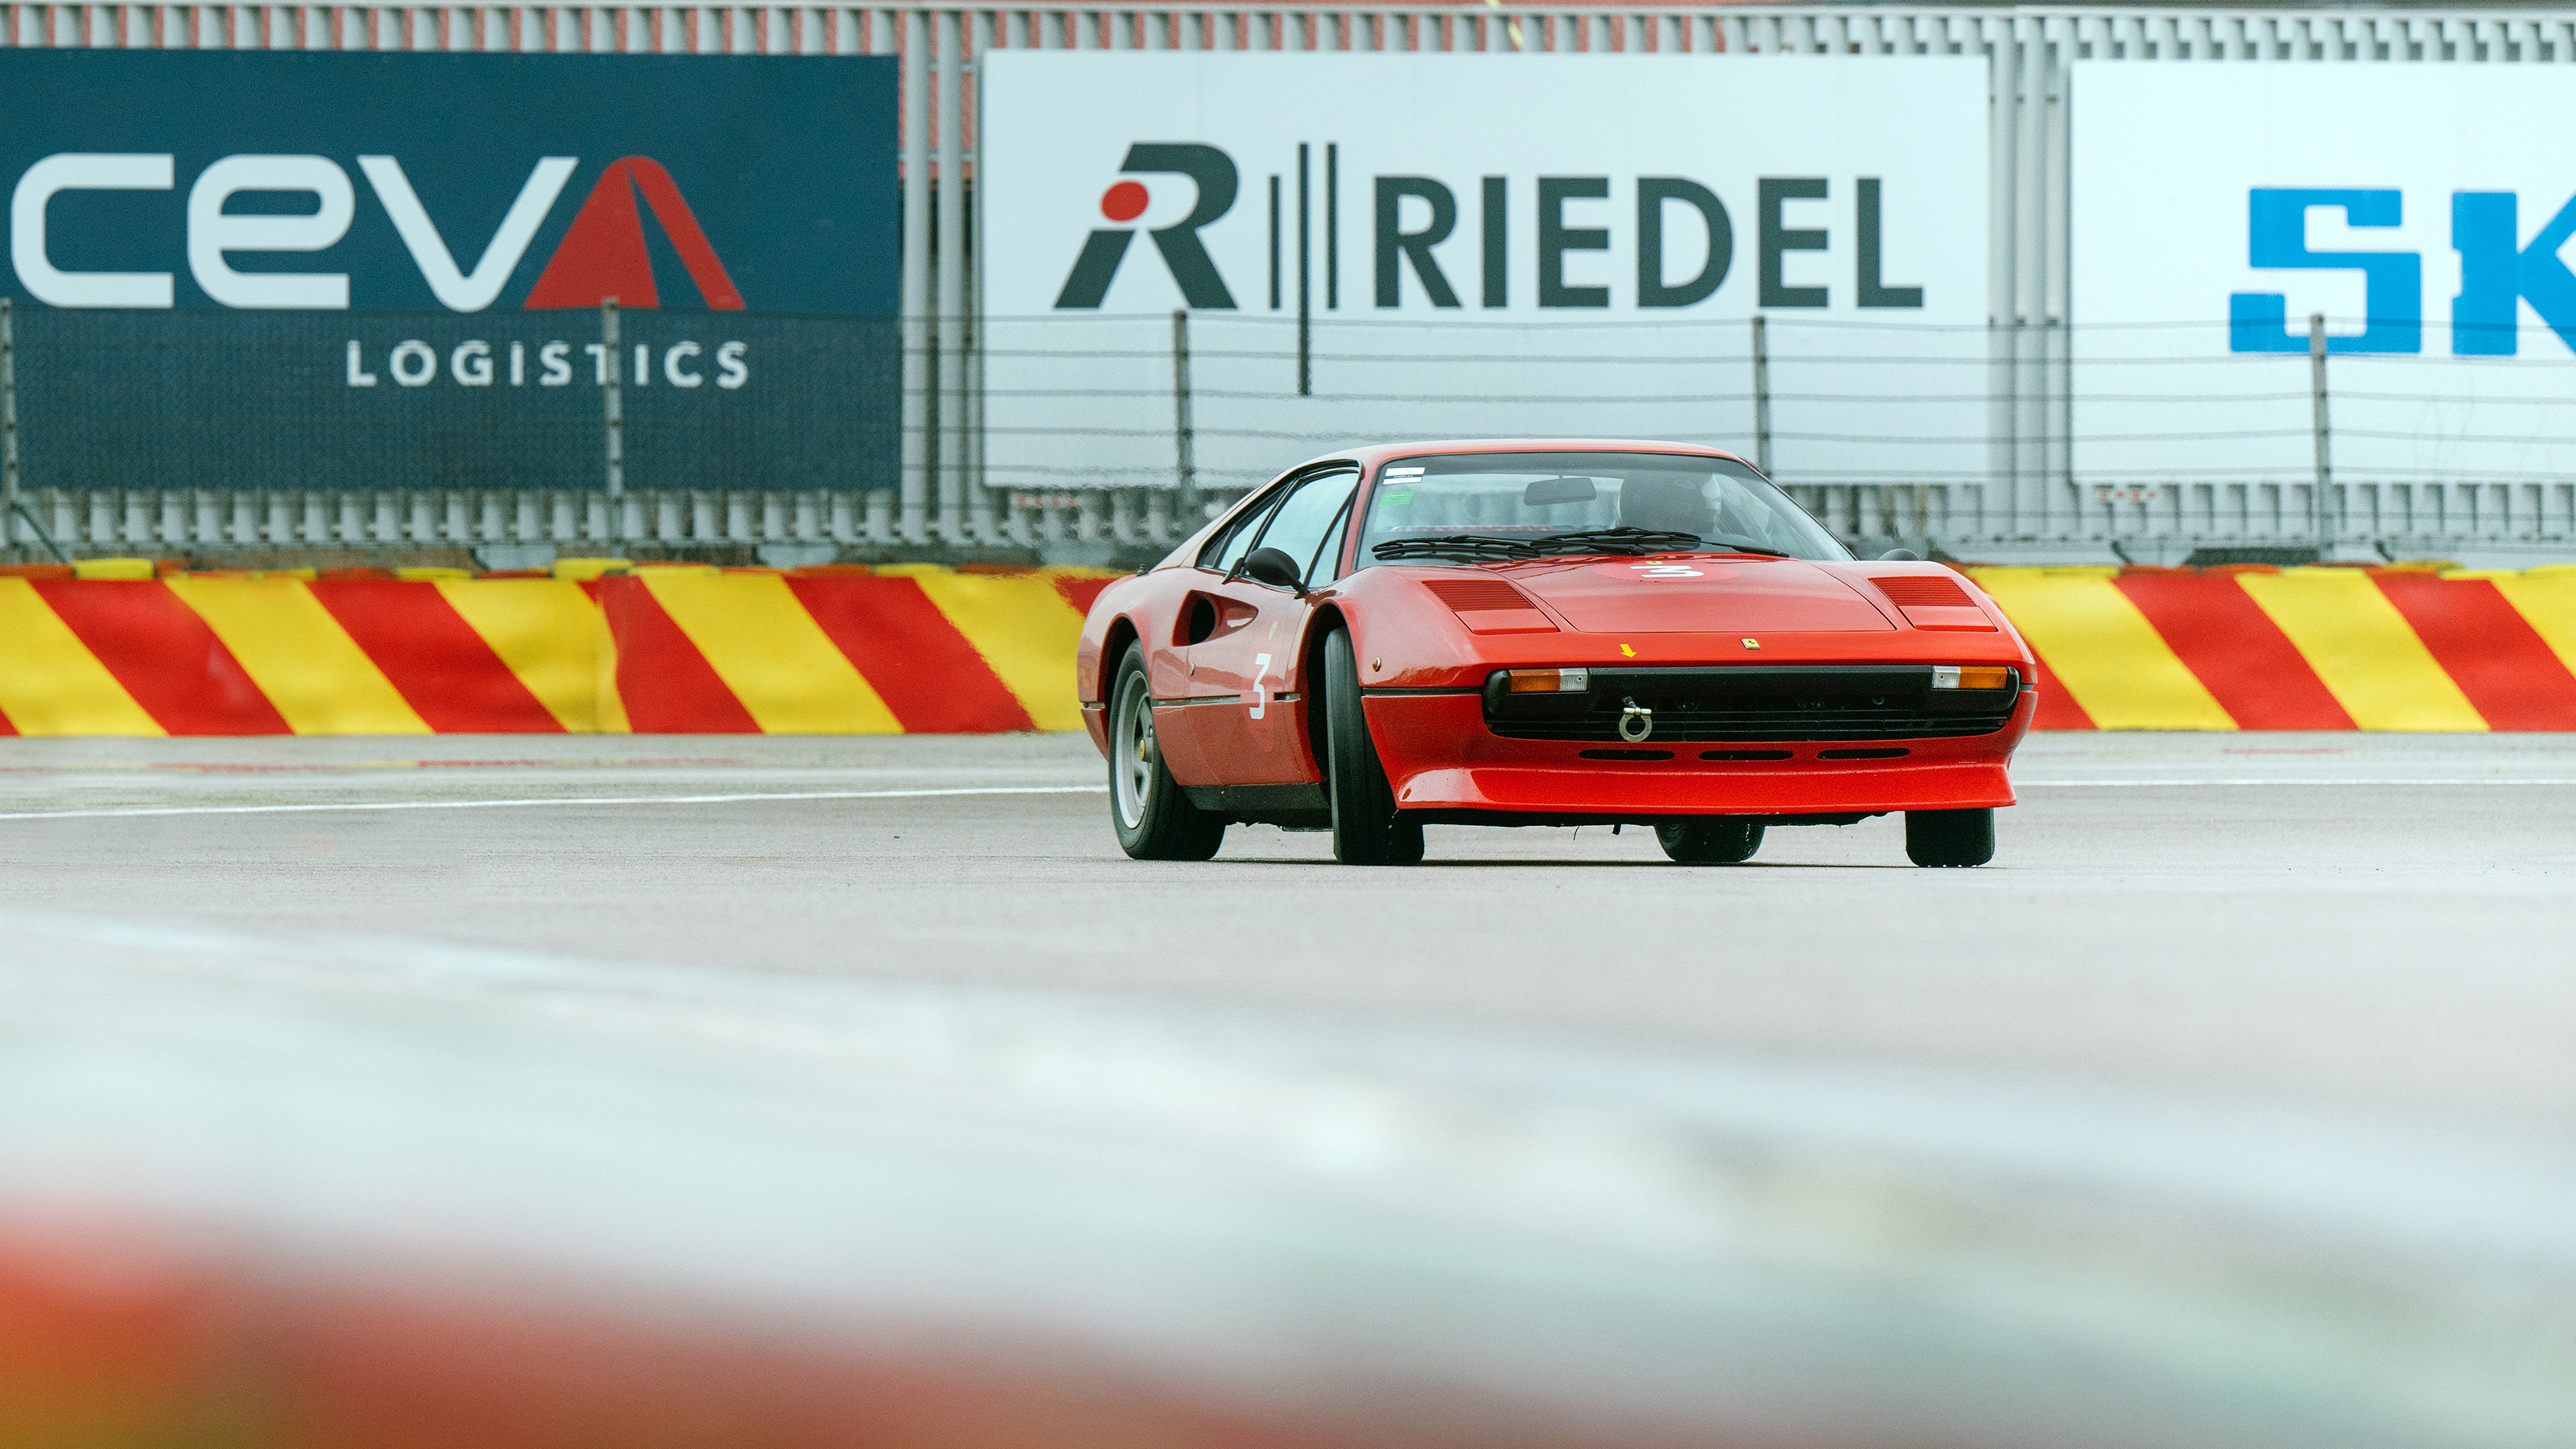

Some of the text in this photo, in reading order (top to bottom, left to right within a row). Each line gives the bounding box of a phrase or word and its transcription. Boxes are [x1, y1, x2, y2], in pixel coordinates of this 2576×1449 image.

[1374, 175, 1925, 309] RIEDEL
[1629, 565, 1704, 578] 3
[1249, 652, 1272, 720] 3
